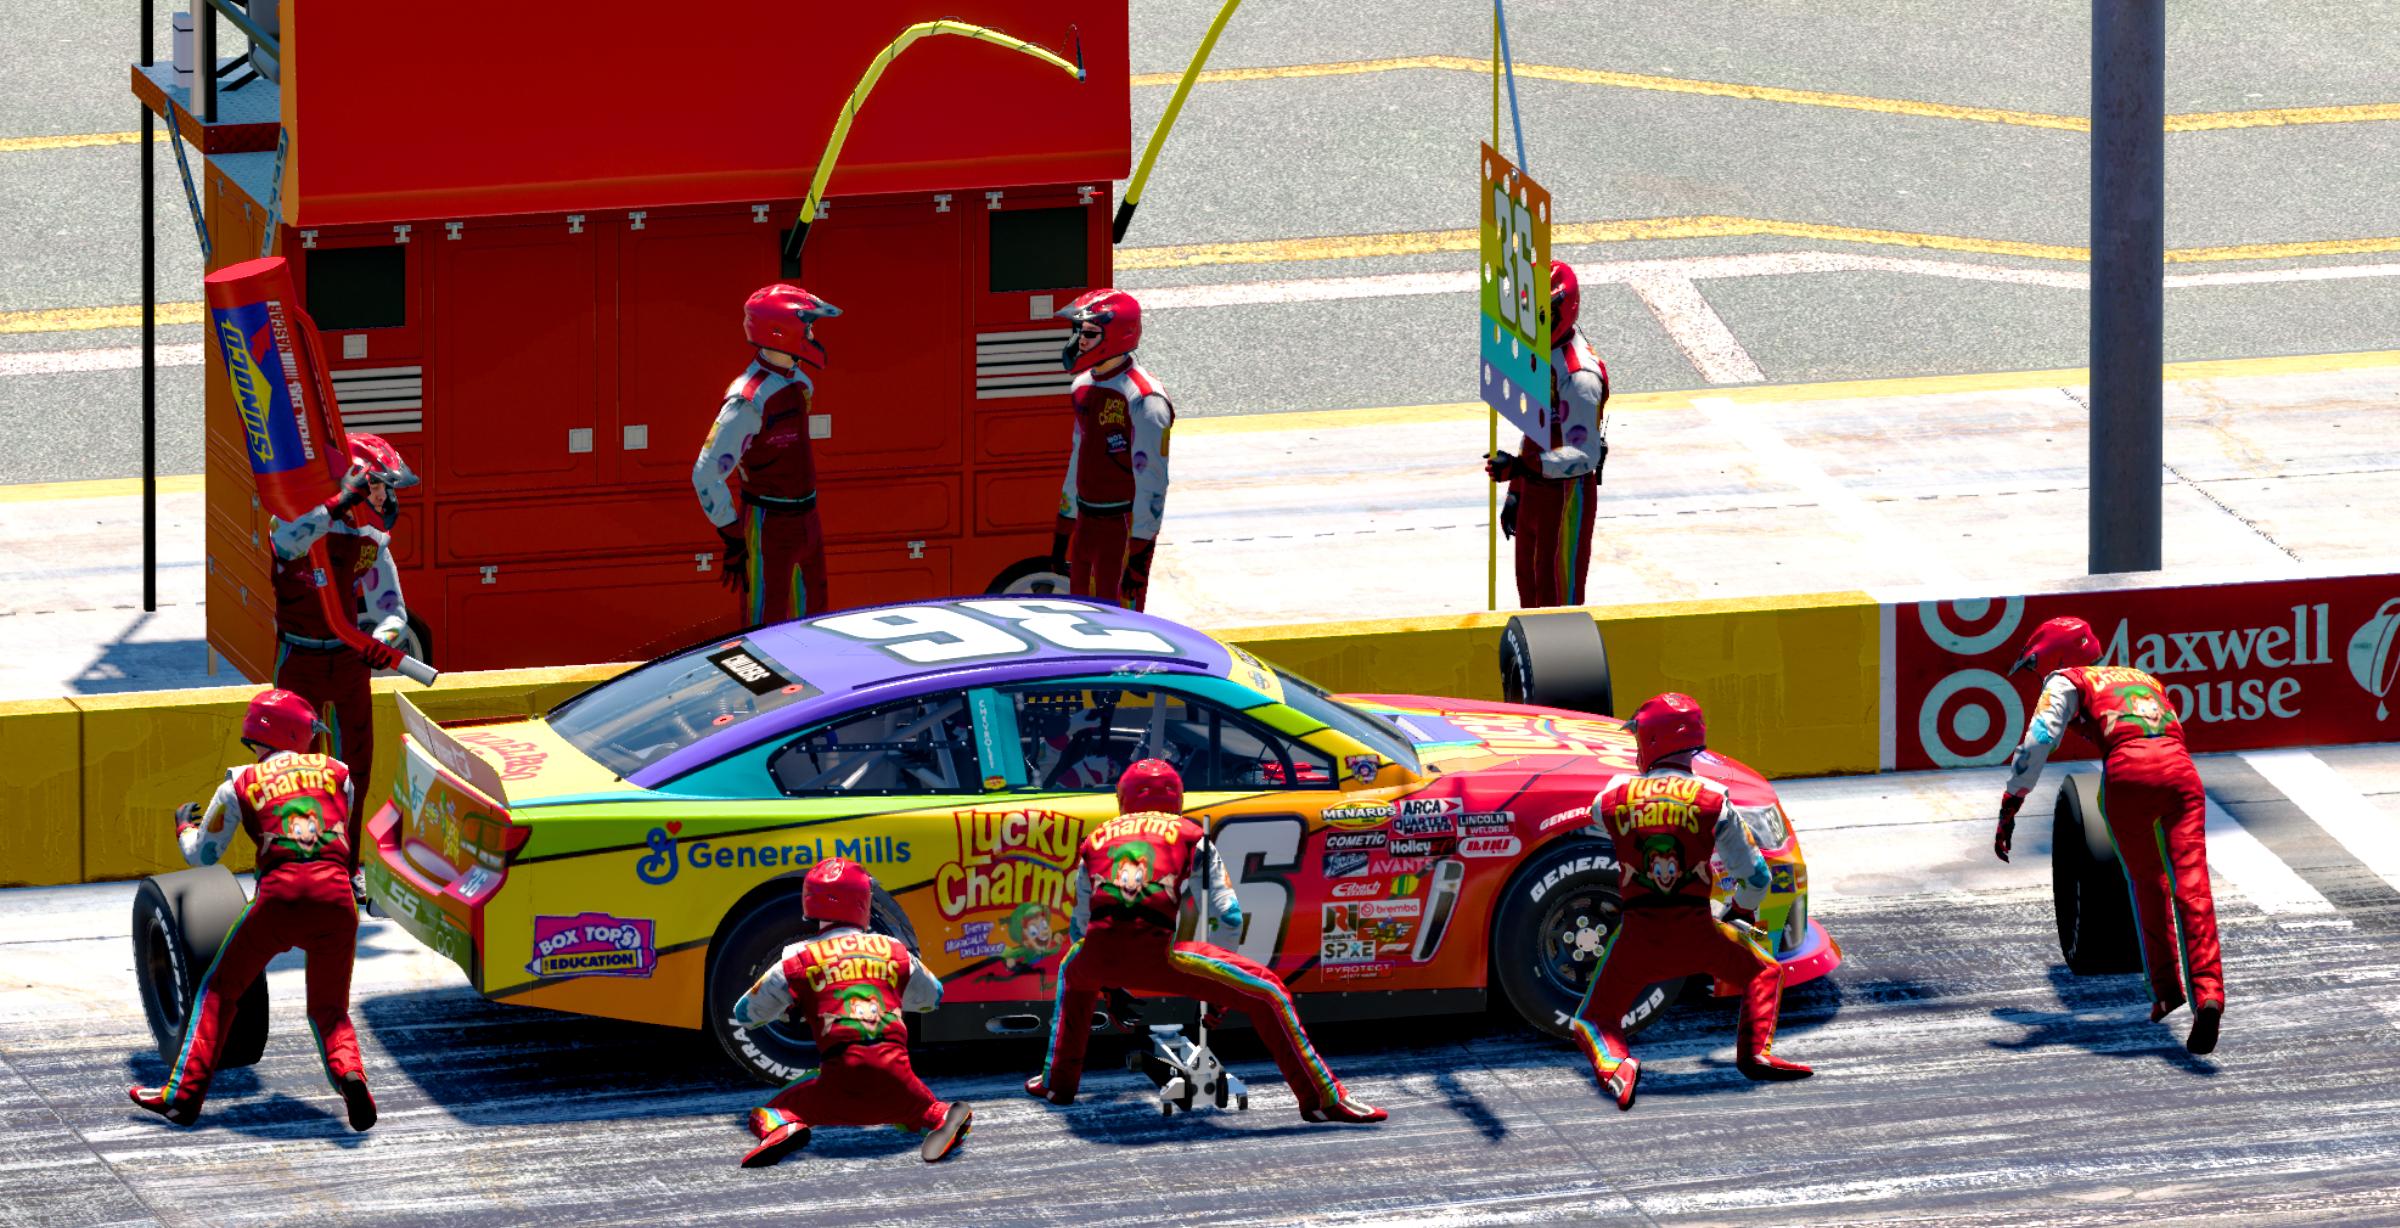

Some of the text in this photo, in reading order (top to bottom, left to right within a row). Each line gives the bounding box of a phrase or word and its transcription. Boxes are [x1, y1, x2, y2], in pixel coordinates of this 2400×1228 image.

[1494, 184, 1537, 343] 36
[220, 318, 274, 464] SUNOCO
[2165, 676, 2302, 724] ouse
[255, 753, 327, 783] Lucky
[245, 768, 337, 812] Charms
[1626, 775, 1701, 806] Lucky
[1321, 806, 1397, 821] MENARDS
[1403, 800, 1442, 816] ARCA
[1459, 814, 1505, 826] LINCOLN
[1539, 806, 1593, 831] GENERA
[1614, 800, 1701, 837] Charms
[953, 808, 1085, 872] Lucky
[1090, 816, 1182, 851] Charms
[1390, 840, 1432, 856] Holley
[688, 836, 912, 869] General Mills
[936, 860, 1079, 918] Charms
[1529, 855, 1622, 904] GENERA
[1376, 903, 1418, 913] brembo
[539, 925, 637, 957] BOX TOPS
[806, 933, 892, 967] Lucky
[550, 953, 634, 970] EDUCATION
[805, 957, 900, 993] Charms
[1326, 963, 1391, 974] PYROTECT
[727, 1018, 816, 1081] ENERA
